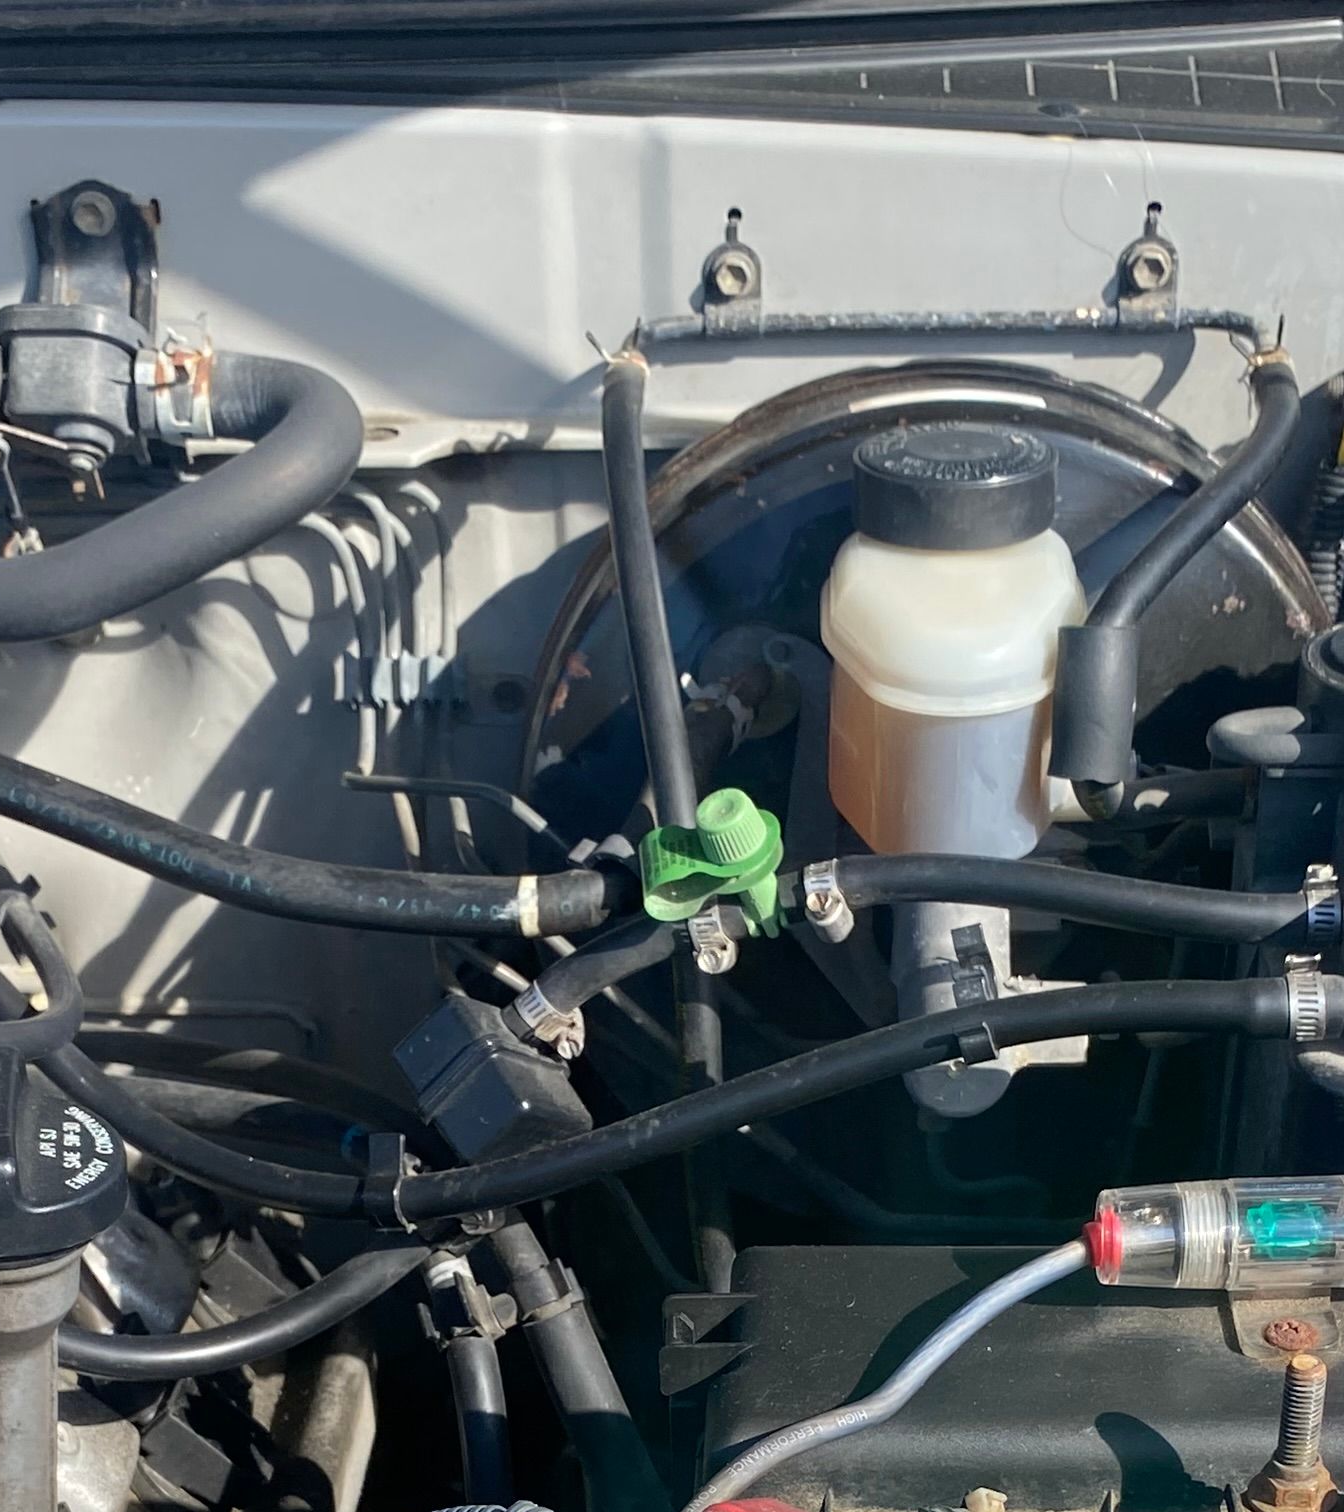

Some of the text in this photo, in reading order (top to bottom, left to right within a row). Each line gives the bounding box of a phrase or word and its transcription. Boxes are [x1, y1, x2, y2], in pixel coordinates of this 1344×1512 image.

[39, 1129, 56, 1158] API SJ
[63, 1151, 82, 1169] SAE
[65, 1158, 108, 1189] ENERGY
[836, 1409, 869, 1428] HIGH
[728, 1423, 823, 1477] PERFORMANCE
